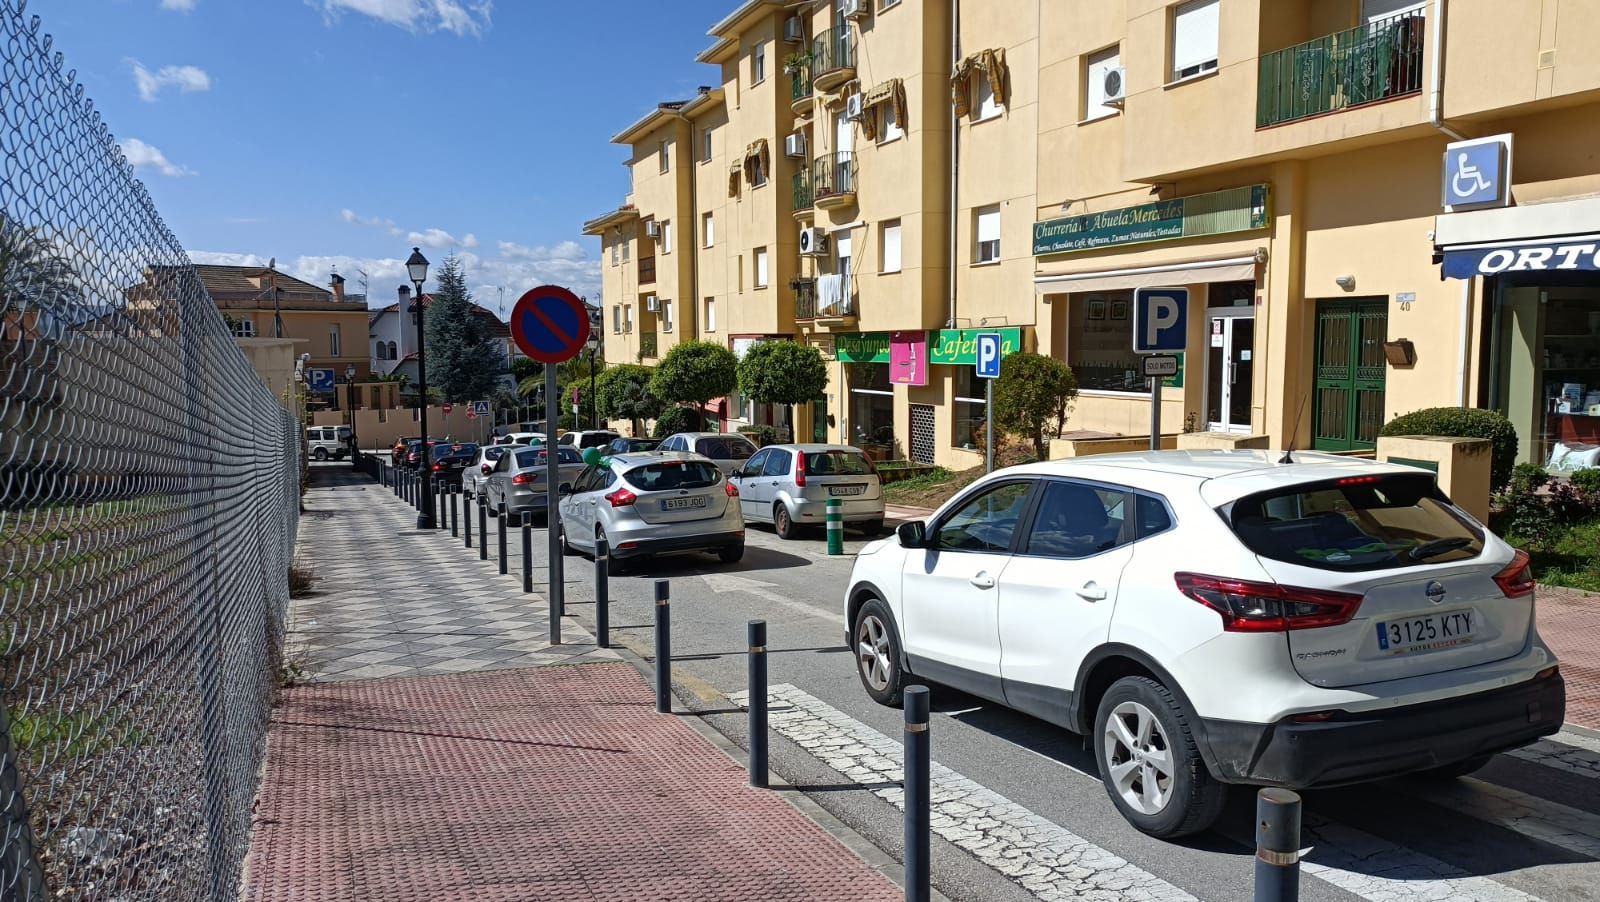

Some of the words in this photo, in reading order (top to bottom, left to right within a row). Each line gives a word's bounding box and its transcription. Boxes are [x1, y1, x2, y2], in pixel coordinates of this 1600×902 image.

[1090, 207, 1128, 232] Abuela
[1129, 201, 1182, 225] Mercedes
[1478, 244, 1600, 273] ORT
[1147, 296, 1179, 346] P
[1400, 301, 1411, 312] 40
[933, 333, 1011, 360] Cafeta
[981, 338, 996, 373] P
[312, 370, 326, 385] P
[1146, 362, 1159, 370] SOLO
[1390, 618, 1436, 644] 3125
[1441, 612, 1471, 637] KTY
